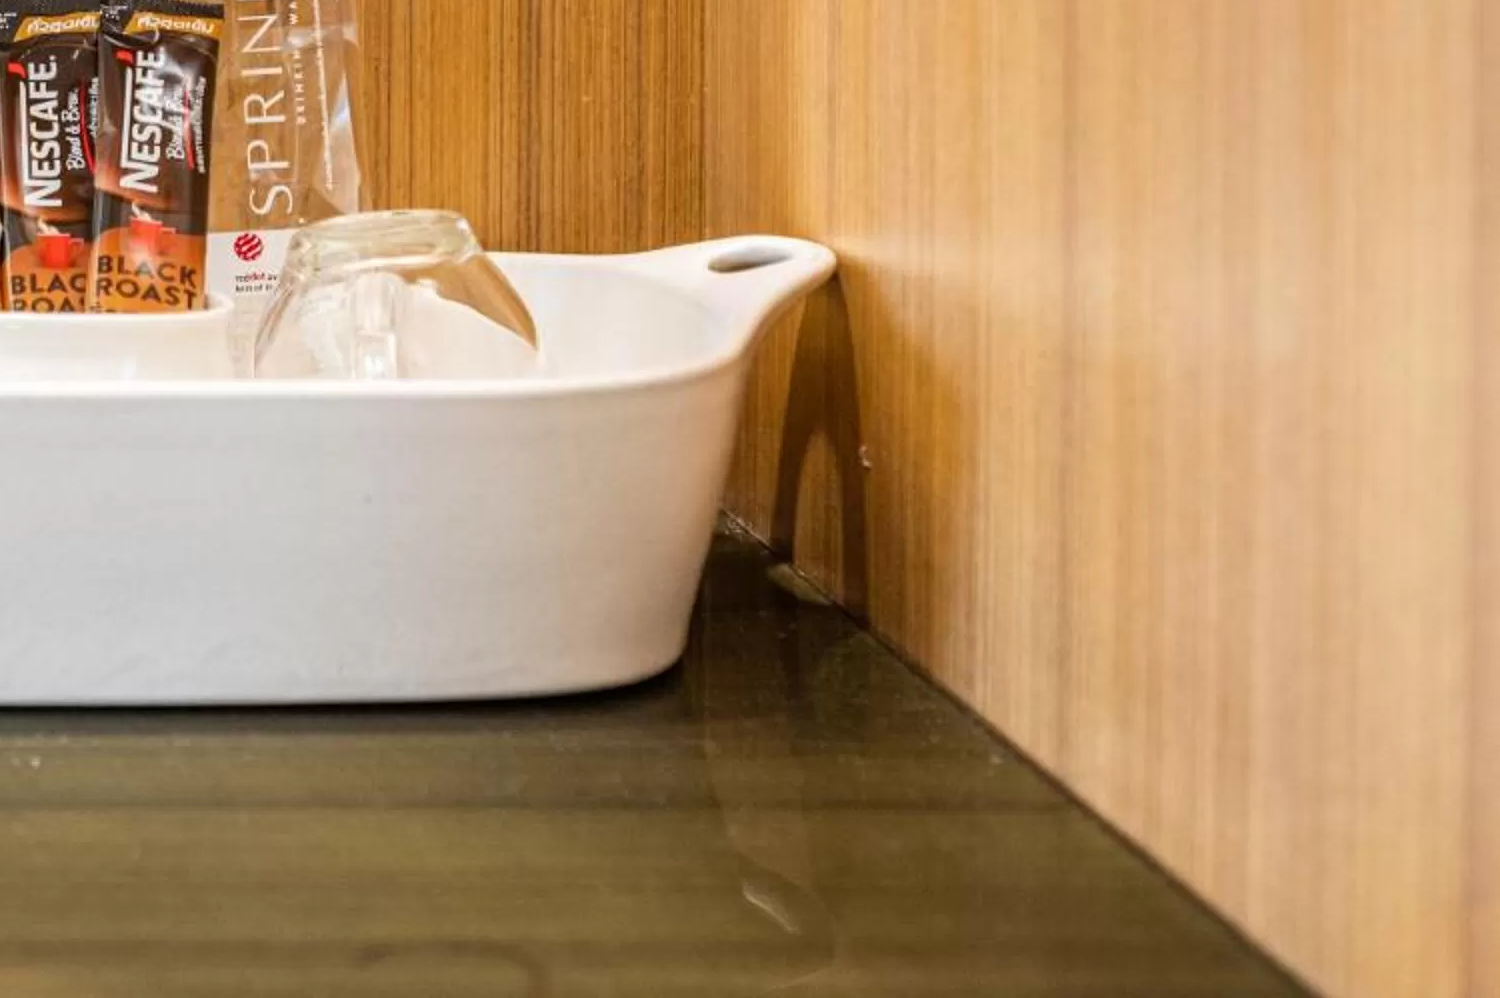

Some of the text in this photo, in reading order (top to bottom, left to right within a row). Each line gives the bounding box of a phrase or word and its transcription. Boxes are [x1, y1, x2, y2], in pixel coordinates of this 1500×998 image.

[11, 273, 86, 295] BLAC
[98, 254, 197, 288] BLACK
[98, 277, 198, 311] ROAST
